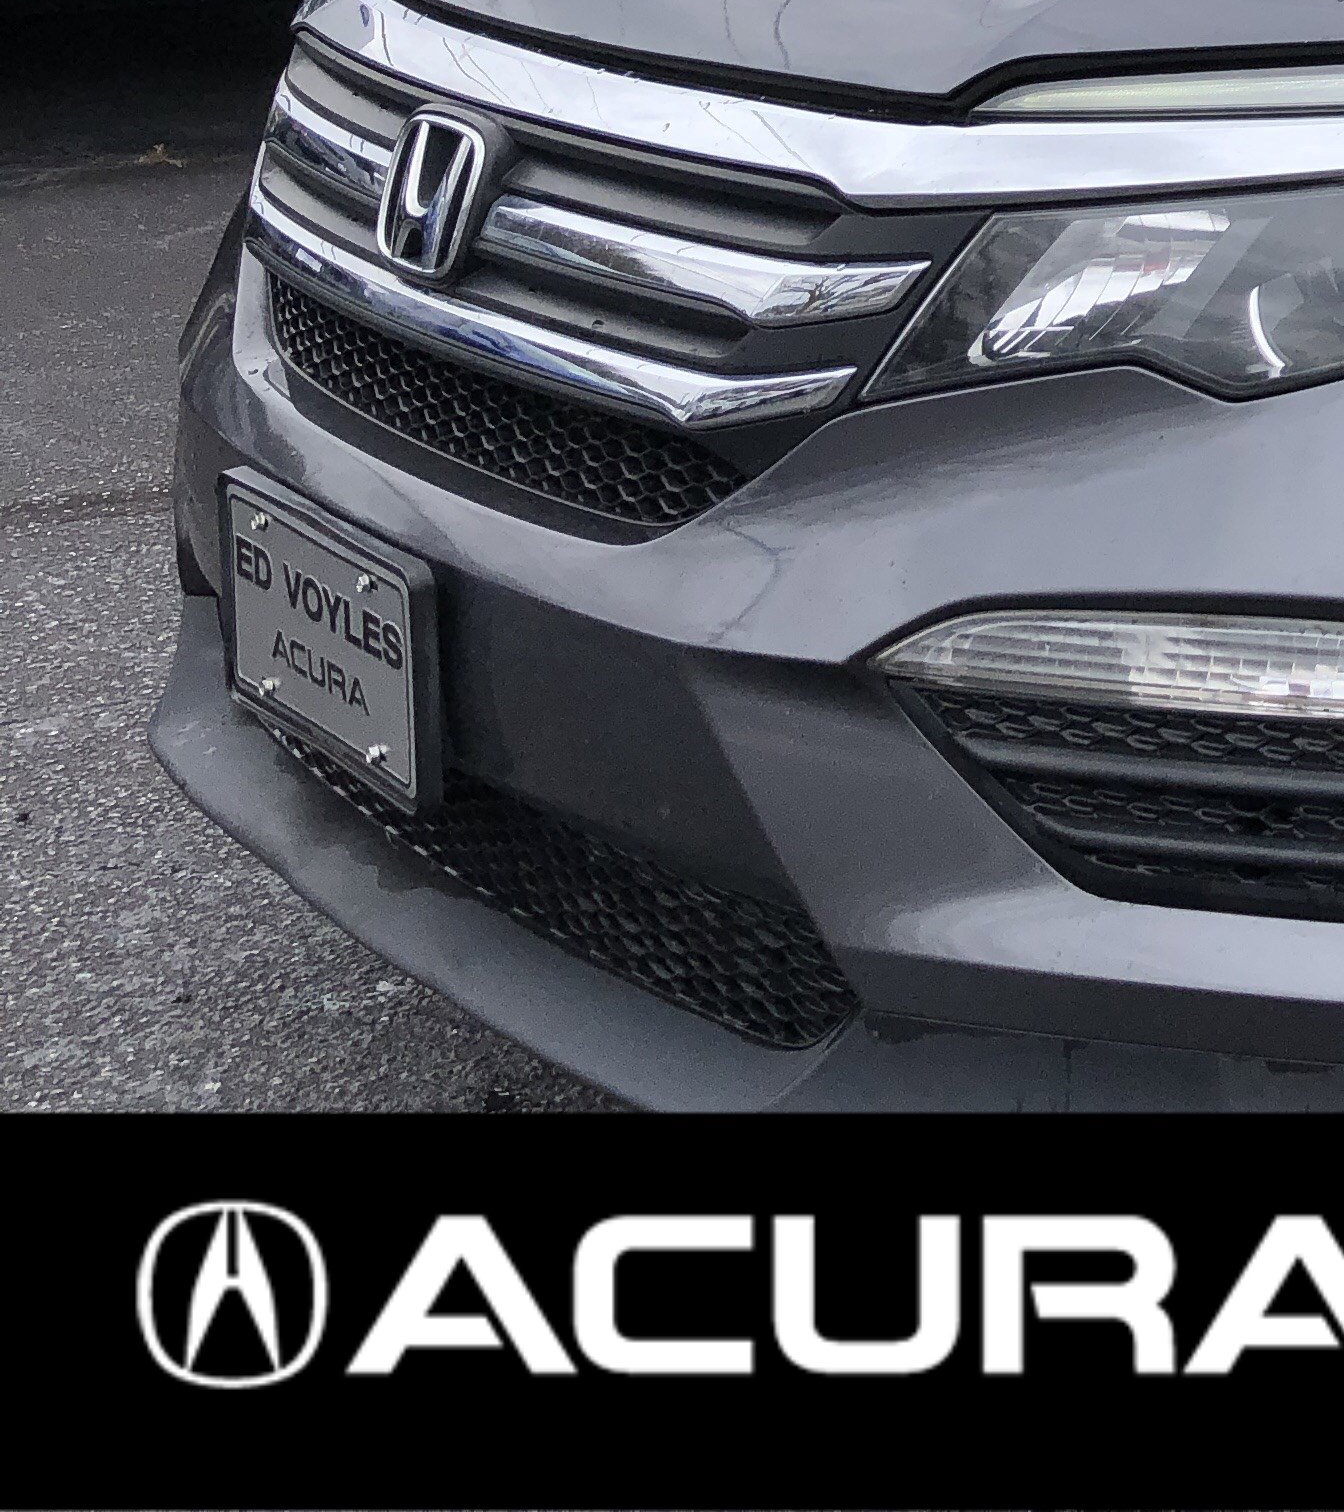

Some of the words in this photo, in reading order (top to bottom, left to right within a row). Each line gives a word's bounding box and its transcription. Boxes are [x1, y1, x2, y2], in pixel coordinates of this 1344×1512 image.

[236, 534, 272, 591] ED
[282, 561, 403, 671] VOYLES
[271, 630, 370, 717] ACURA
